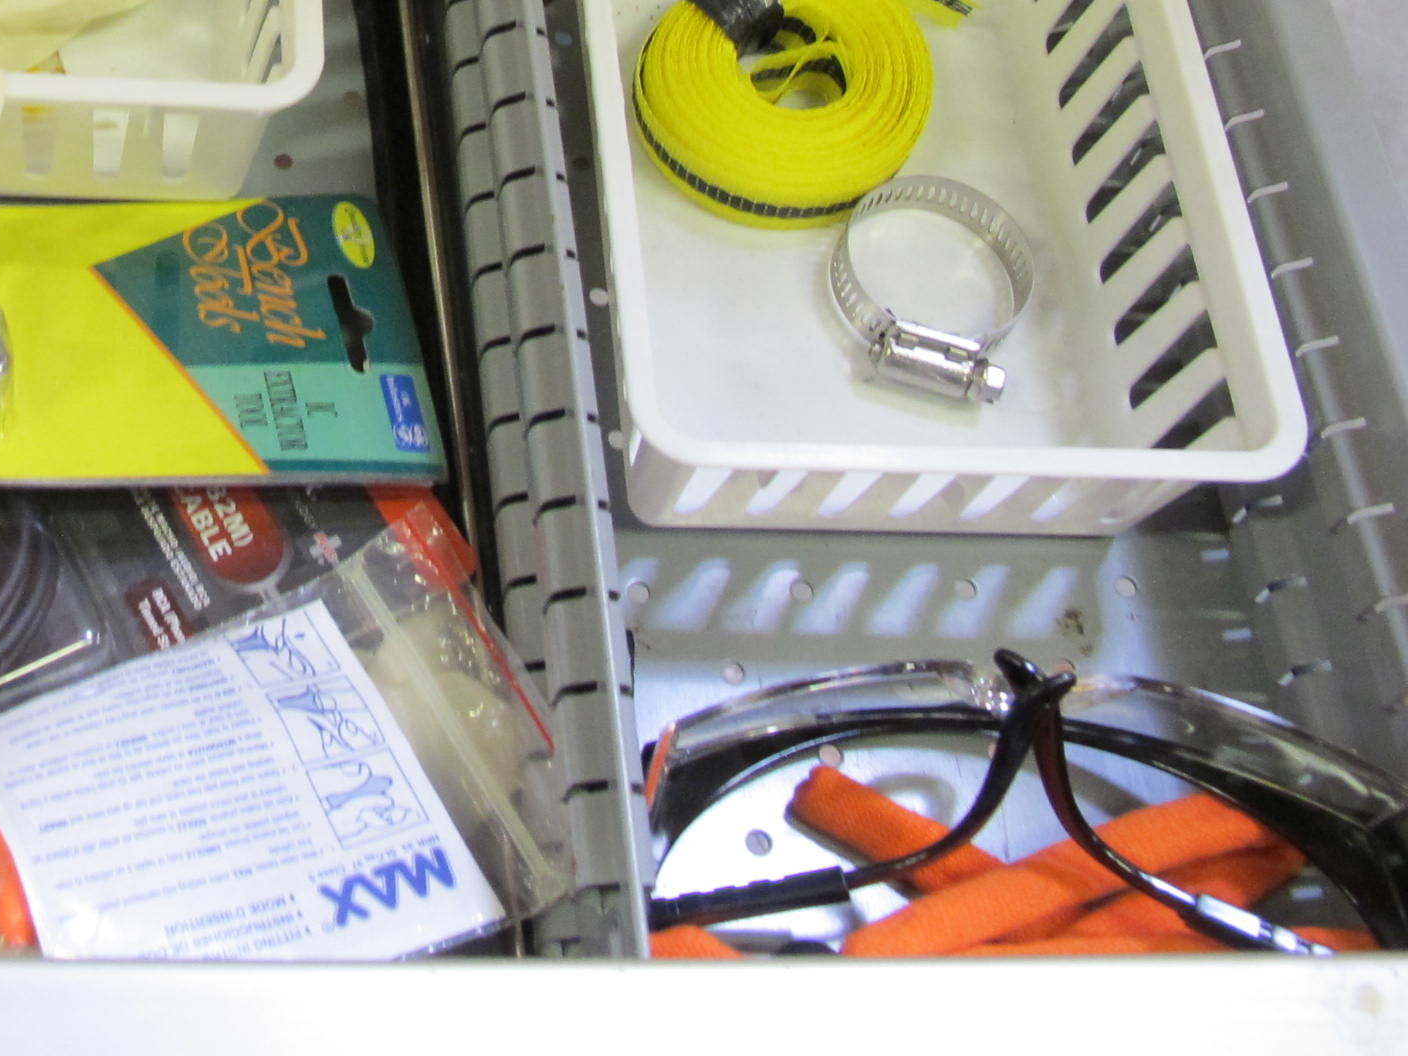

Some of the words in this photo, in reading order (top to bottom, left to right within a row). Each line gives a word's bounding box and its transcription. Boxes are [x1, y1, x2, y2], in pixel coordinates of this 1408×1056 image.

[183, 221, 260, 333] Tools
[237, 201, 326, 348] Bench
[163, 906, 246, 937] D'INSERTION
[248, 896, 287, 915] MODE
[319, 846, 456, 927] MAX
